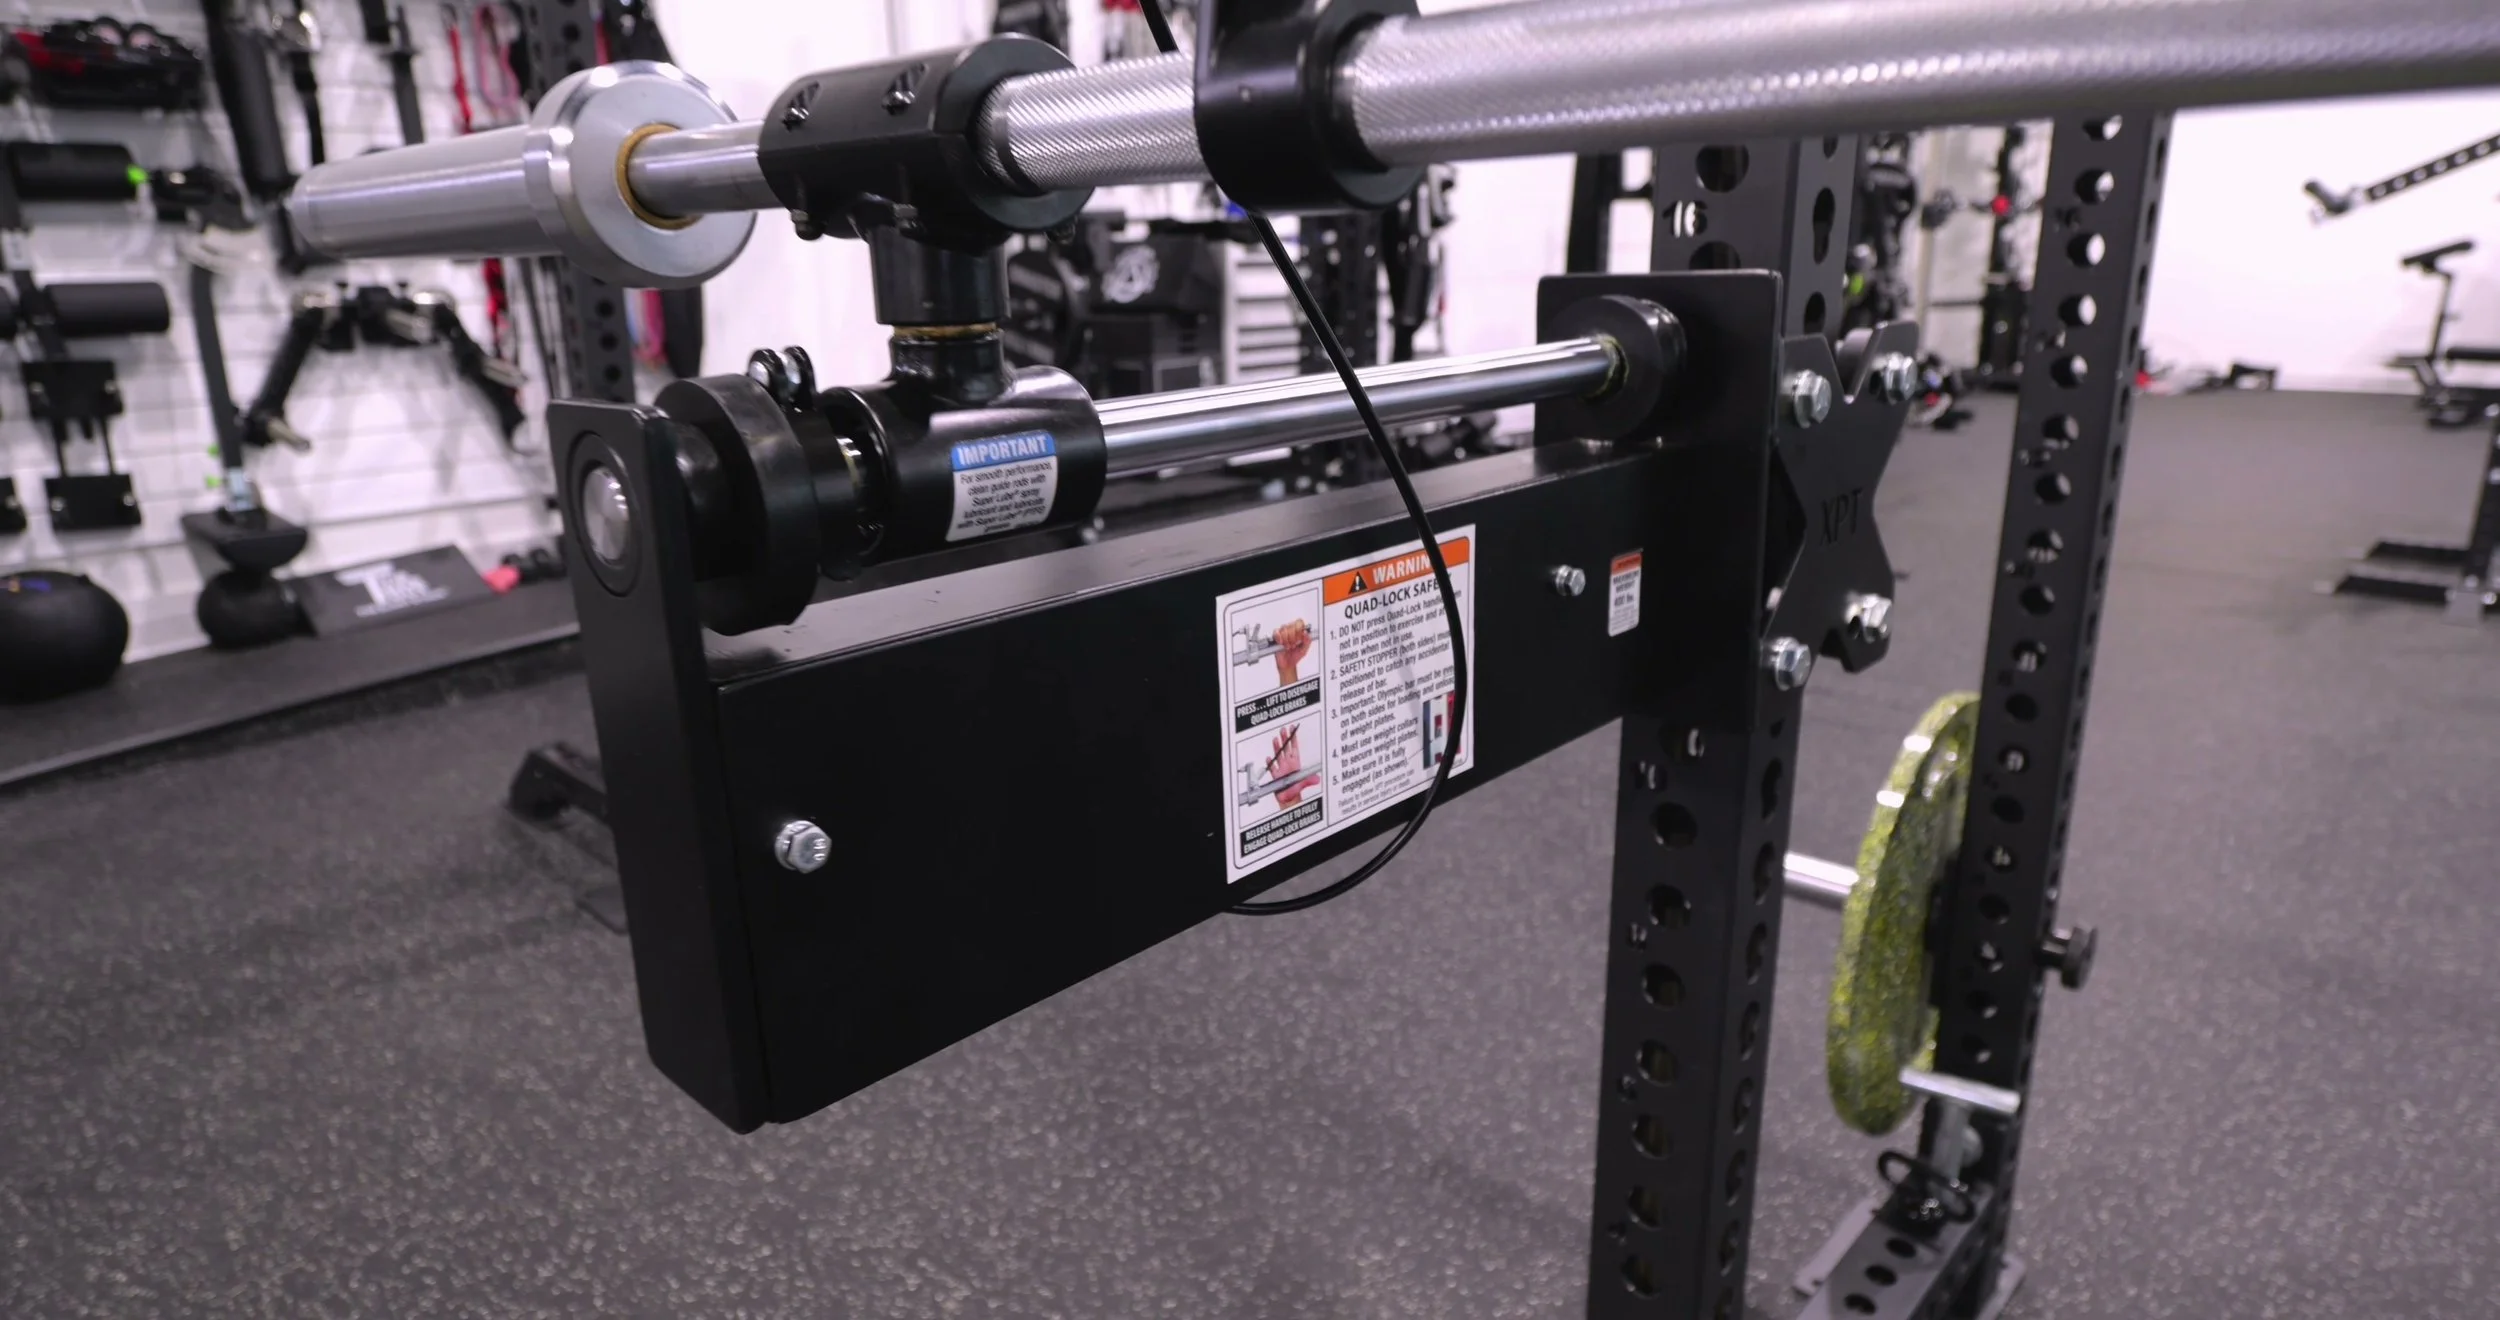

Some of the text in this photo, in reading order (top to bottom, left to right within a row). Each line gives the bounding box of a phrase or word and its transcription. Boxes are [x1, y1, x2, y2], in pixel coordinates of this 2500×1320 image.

[1662, 200, 1707, 238] 16
[957, 435, 1047, 466] IMPORTANT
[1820, 487, 1863, 546] XPT
[1372, 554, 1431, 585] WARNIN
[1344, 586, 1411, 619] QUAD-LOCK
[1339, 625, 1348, 637] DO
[1351, 620, 1364, 633] NOT
[1366, 615, 1384, 629] press
[1386, 601, 1421, 621] Quad-Lock
[1339, 639, 1350, 650] not
[1352, 635, 1359, 645] in
[1360, 626, 1387, 645] position
[1389, 623, 1396, 632] to
[1397, 613, 1423, 630] exercise
[1425, 609, 1436, 621] and
[1339, 648, 1358, 663] times
[1360, 641, 1378, 656] when
[1380, 637, 1391, 649] not
[1339, 658, 1365, 676] SAFETY
[1367, 647, 1397, 666] STOPPER
[1339, 667, 1375, 691] positioned
[1377, 665, 1383, 675] to
[1385, 657, 1403, 672] catch
[1404, 655, 1415, 667] any
[1377, 682, 1403, 702] Olympic
[1404, 678, 1414, 690] bar
[1417, 672, 1432, 685] must
[1434, 668, 1441, 678] be
[1287, 680, 1318, 699] DISENGAGE
[1340, 685, 1364, 702] release
[1366, 681, 1373, 692] of
[1250, 695, 1306, 725] QUAD-LOCK BRAKES
[1340, 718, 1349, 728] on
[1351, 710, 1366, 724] both
[1368, 702, 1385, 717] sides
[1387, 698, 1395, 709] for
[1397, 688, 1420, 707] loading
[1422, 683, 1433, 695] and
[1340, 729, 1347, 741] of
[1349, 719, 1372, 740] weight
[1341, 739, 1358, 755] Must
[1359, 736, 1371, 747] use
[1373, 724, 1395, 743] weight
[1341, 764, 1360, 781] Make
[1362, 759, 1376, 772] sure
[1392, 744, 1405, 760] fully
[1350, 748, 1372, 764] secure
[1374, 736, 1396, 755] weight
[1341, 773, 1370, 796] engaged
[1246, 822, 1270, 841] RELEASE
